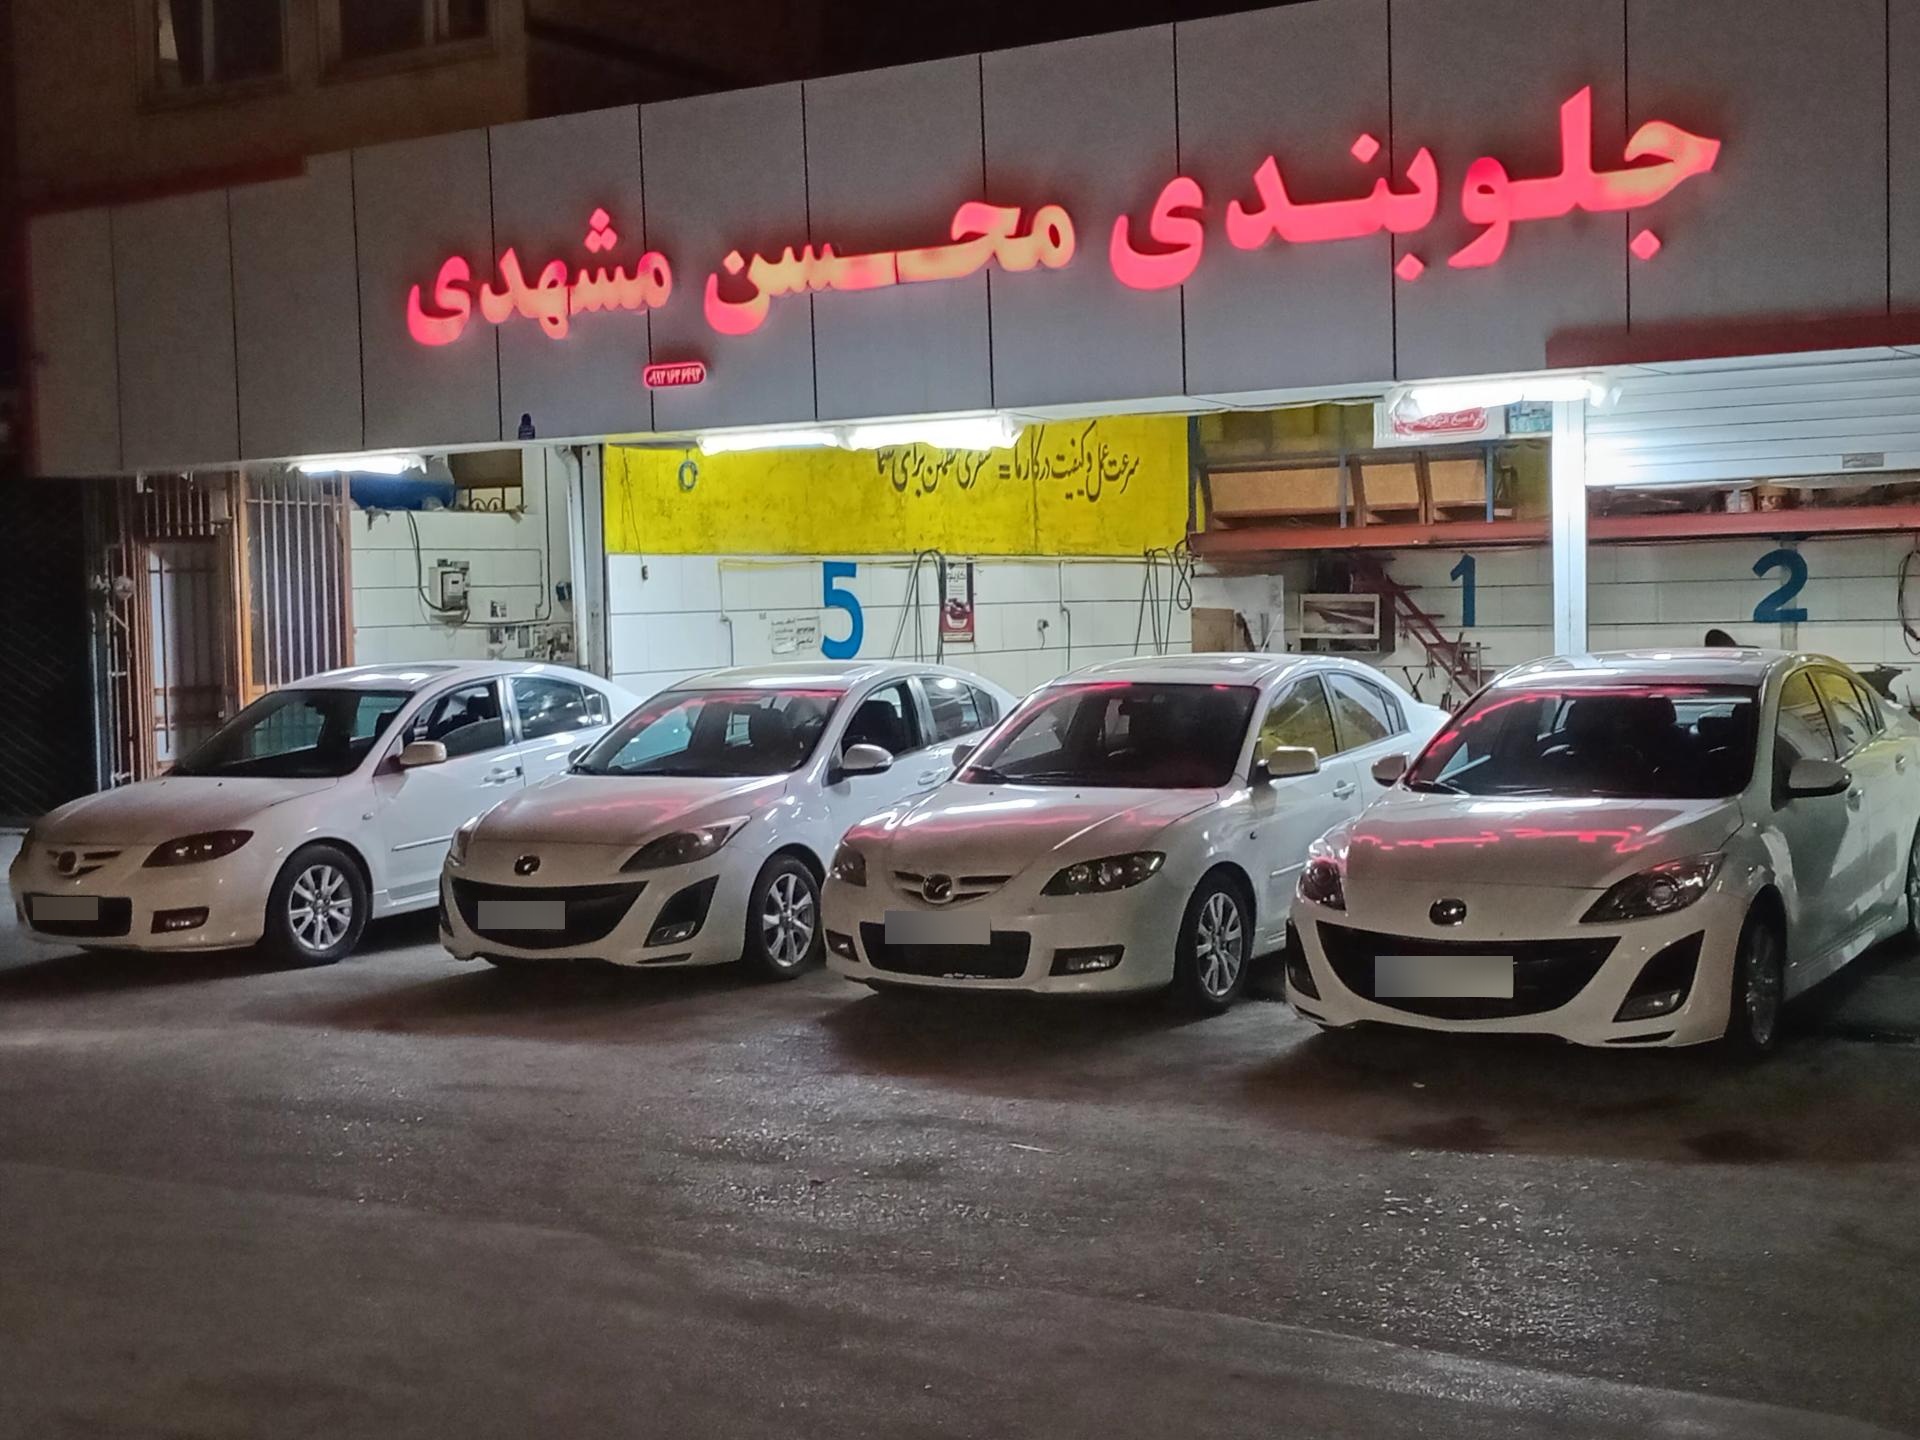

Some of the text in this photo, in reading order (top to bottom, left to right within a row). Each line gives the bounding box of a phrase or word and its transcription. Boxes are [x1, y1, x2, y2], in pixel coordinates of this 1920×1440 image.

[407, 86, 1721, 346] جلوبندی محسن مشهدی
[1051, 419, 1097, 500] کیفیت
[1103, 453, 1140, 495] سرعت
[821, 560, 864, 660] 5
[1450, 554, 1476, 628] 1
[1752, 549, 1808, 623] 2
